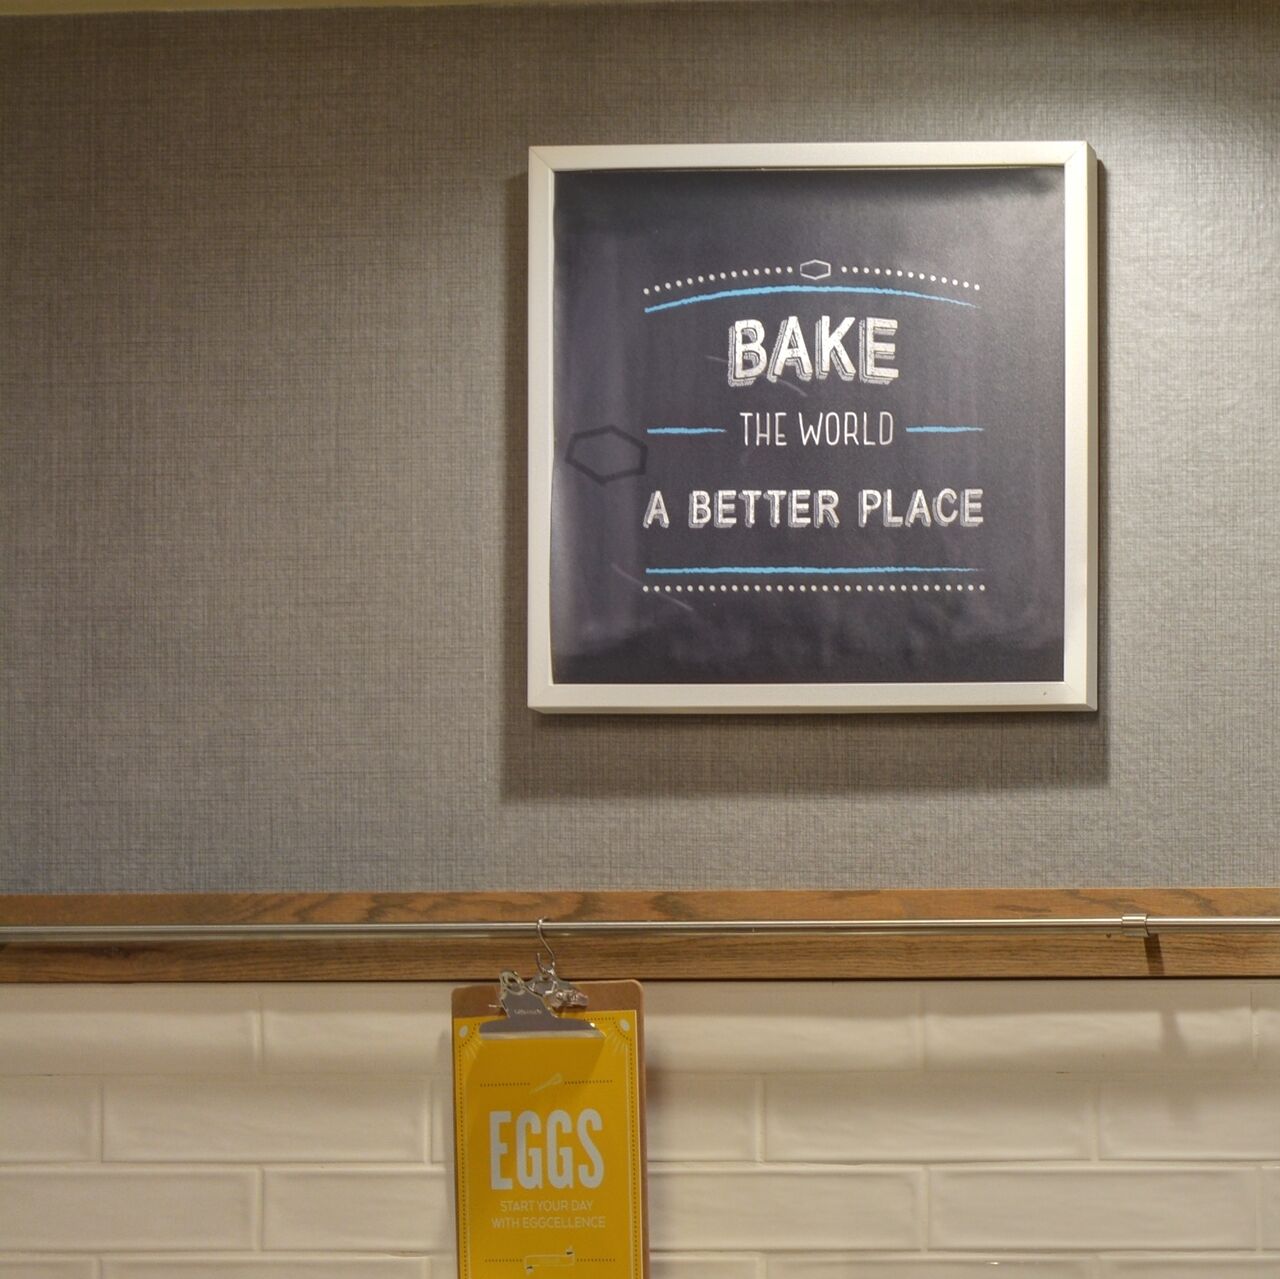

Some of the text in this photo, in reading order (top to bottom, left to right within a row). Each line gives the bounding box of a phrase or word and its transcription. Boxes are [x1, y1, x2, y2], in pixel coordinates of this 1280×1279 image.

[728, 316, 899, 387] BAKE
[740, 411, 894, 446] THE WORLD
[643, 488, 984, 528] A BETTER PLACE
[488, 1108, 605, 1191] EGGS
[491, 1217, 519, 1229] WITH
[500, 1200, 594, 1212] START YOUR DAY
